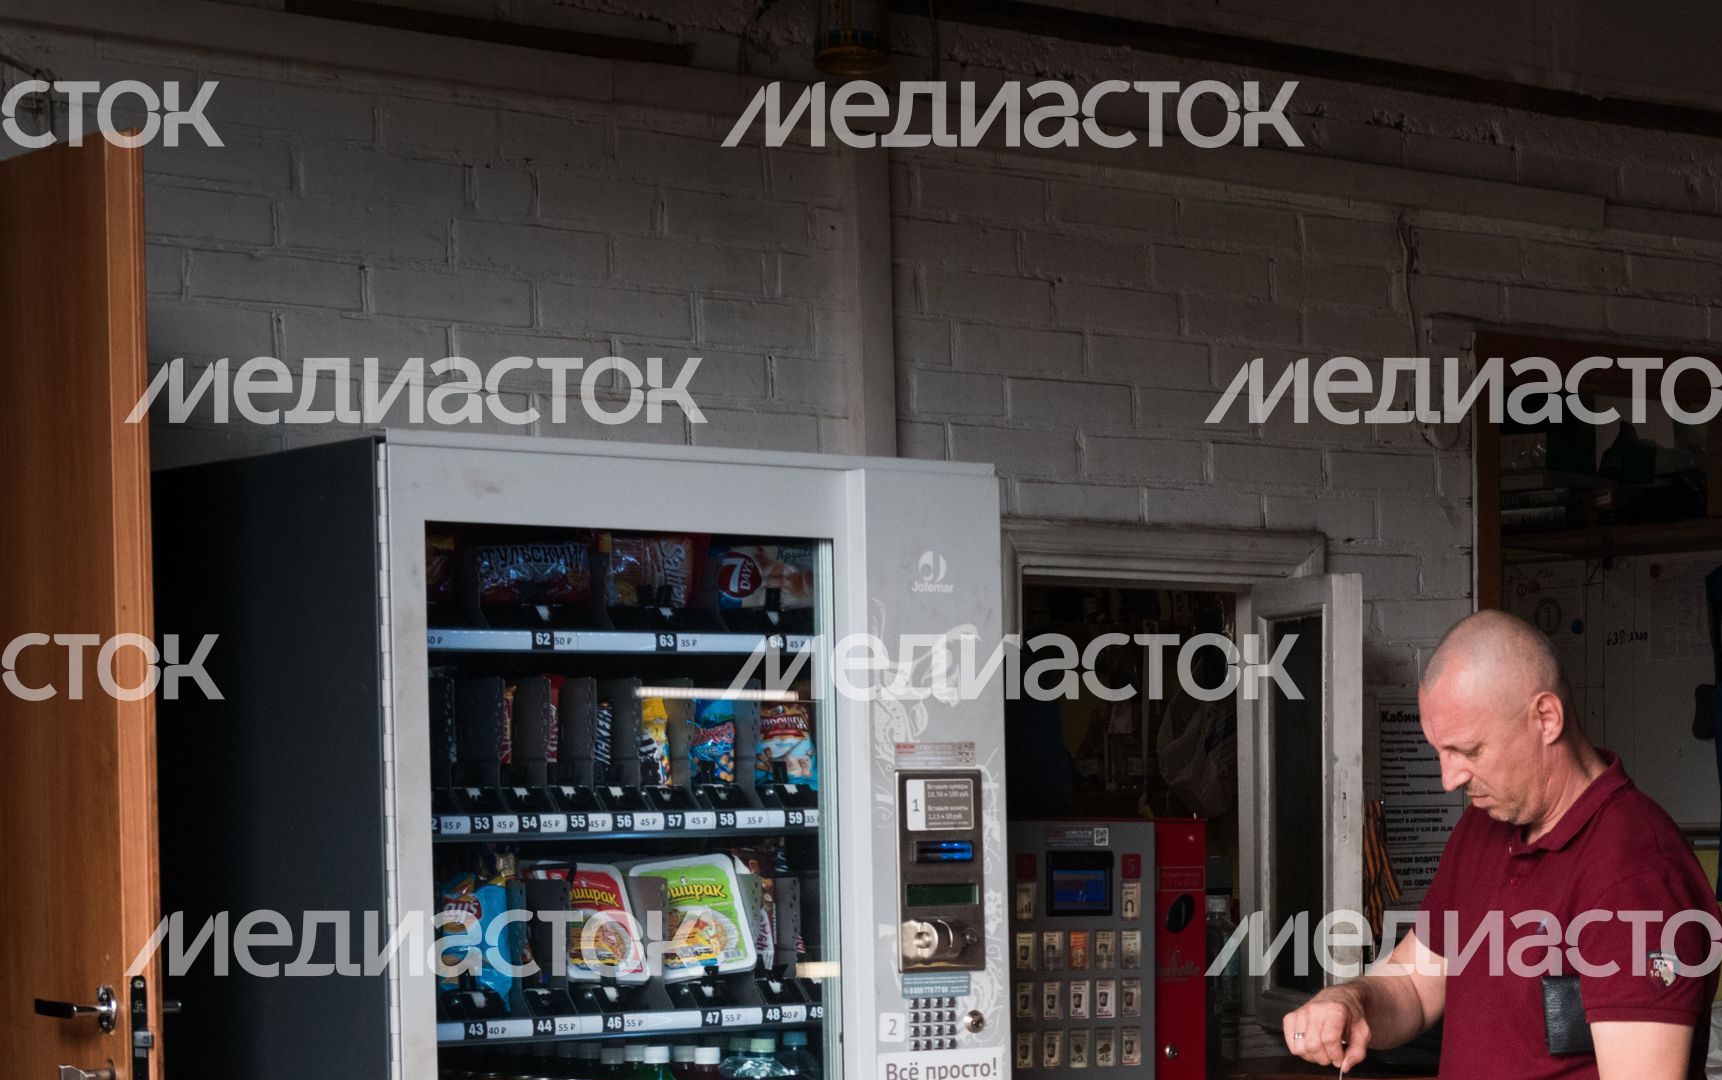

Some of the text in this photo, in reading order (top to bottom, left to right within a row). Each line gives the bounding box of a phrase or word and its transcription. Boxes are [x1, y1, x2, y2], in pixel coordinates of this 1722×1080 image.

[740, 559, 755, 591] DAYS
[535, 633, 551, 646] 62
[659, 634, 674, 647] 63
[770, 636, 784, 648] 64
[1381, 711, 1420, 722] Кабин
[912, 798, 920, 812] 1
[474, 816, 490, 829] 53
[522, 816, 537, 828] 54
[570, 815, 586, 828] 55
[617, 815, 632, 827] 56
[667, 814, 683, 827] 57
[719, 813, 734, 825] 58
[788, 812, 803, 824] 59
[705, 1012, 720, 1024] 47
[766, 1008, 780, 1021] 48
[537, 1019, 552, 1032] 44
[607, 1016, 622, 1029] 46
[888, 1018, 897, 1036] 2
[468, 1023, 484, 1036] 43
